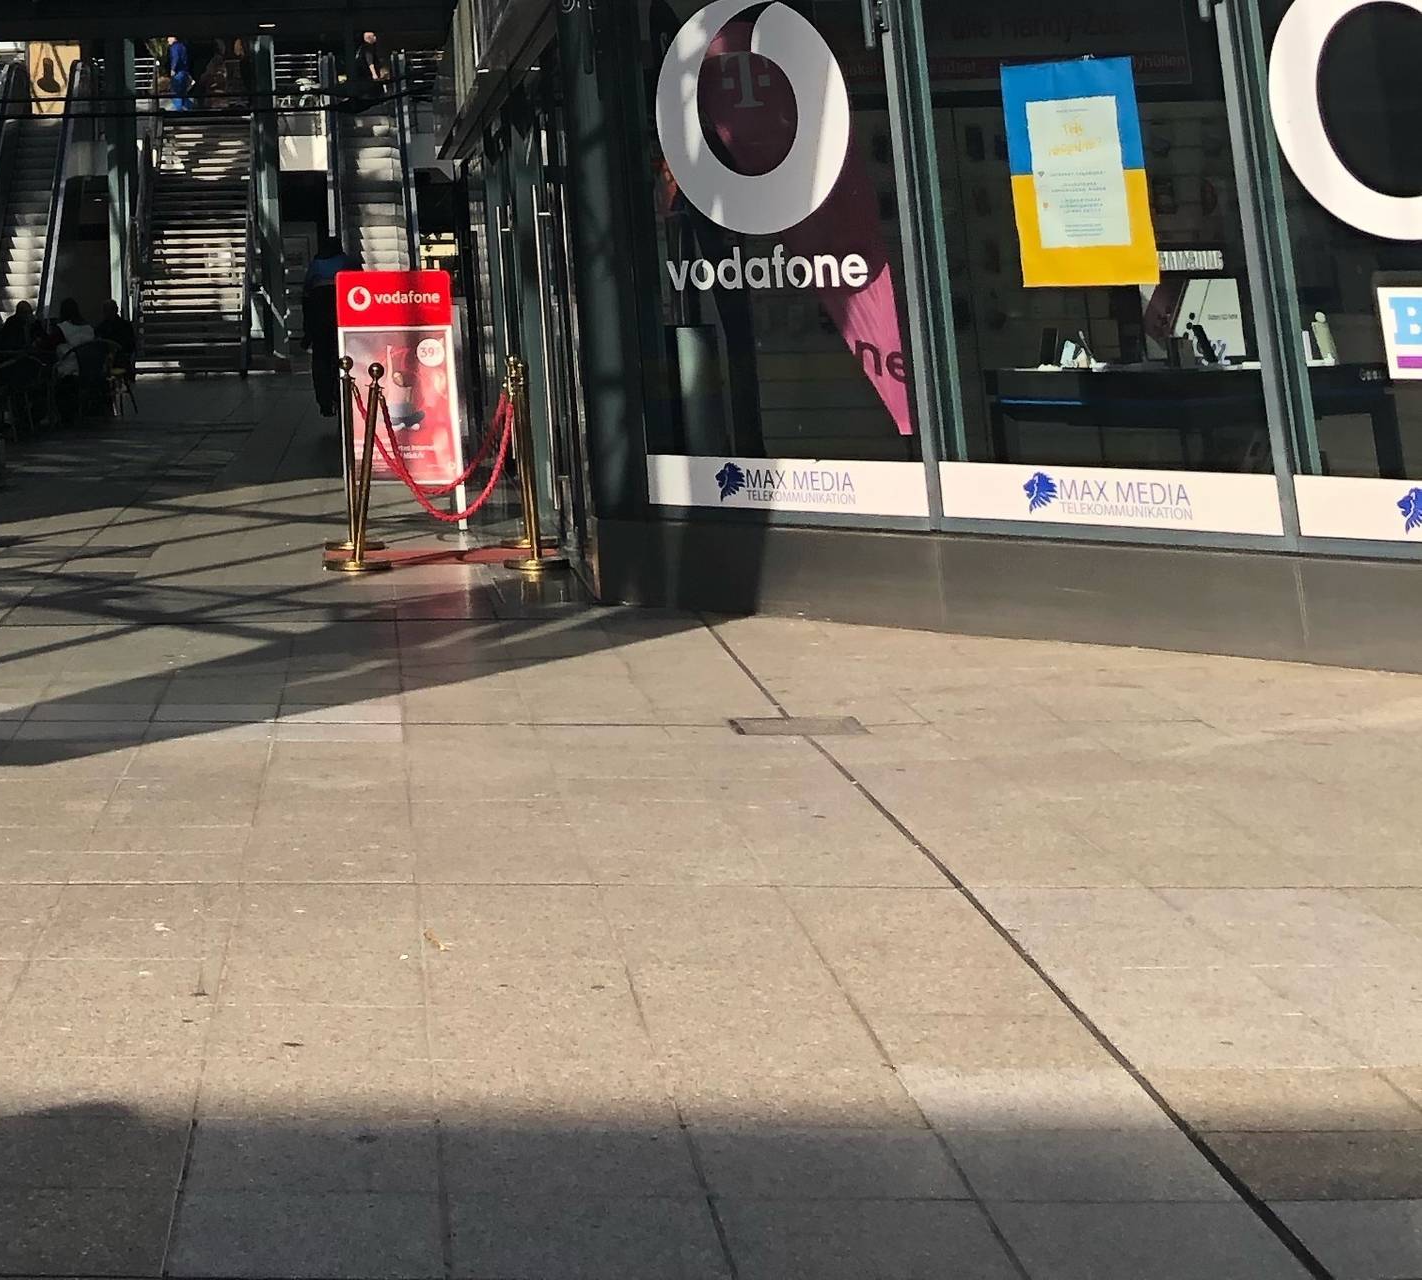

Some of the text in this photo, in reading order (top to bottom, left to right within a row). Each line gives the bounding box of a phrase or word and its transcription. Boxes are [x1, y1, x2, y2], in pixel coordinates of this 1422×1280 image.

[666, 243, 868, 291] vodafone
[374, 289, 441, 305] vodafone
[746, 468, 855, 493] MAX MEDIA
[746, 490, 857, 505] TELEKOMMUNIKATION
[1059, 479, 1192, 507] MAX MEDIA
[1060, 501, 1194, 521] TELEKOMMUNIKATION
